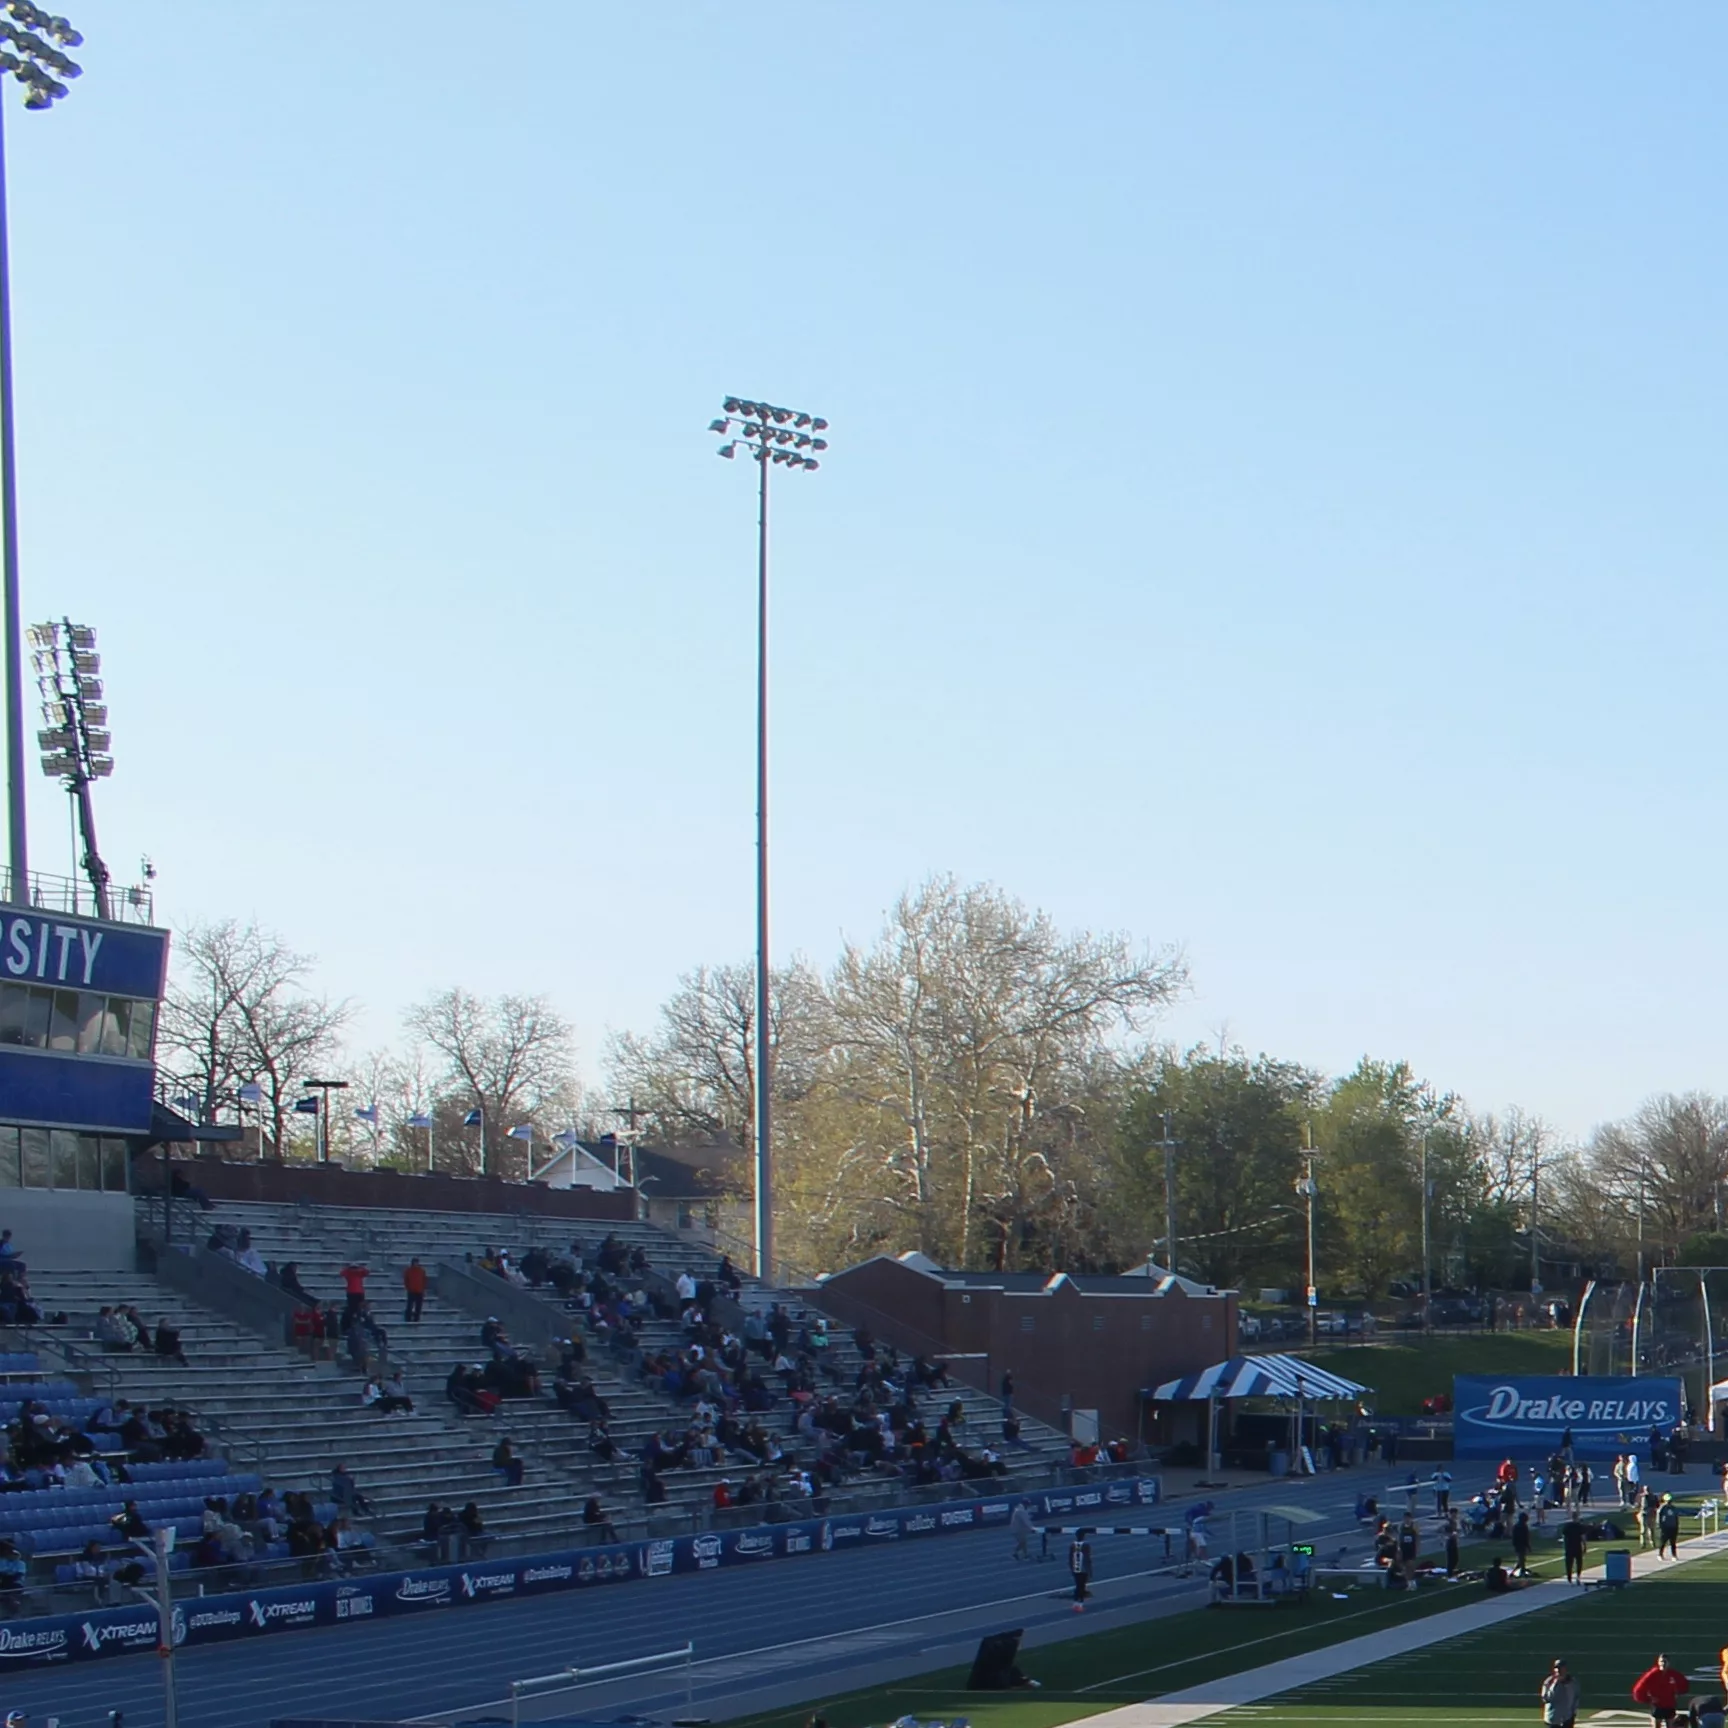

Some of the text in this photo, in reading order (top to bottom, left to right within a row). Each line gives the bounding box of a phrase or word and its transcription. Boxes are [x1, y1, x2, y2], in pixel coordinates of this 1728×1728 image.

[0, 917, 104, 985] SITY
[1485, 1386, 1669, 1421] Drake RELAYS
[265, 1600, 316, 1618] XTREAM
[100, 1620, 158, 1642] XTREAM
